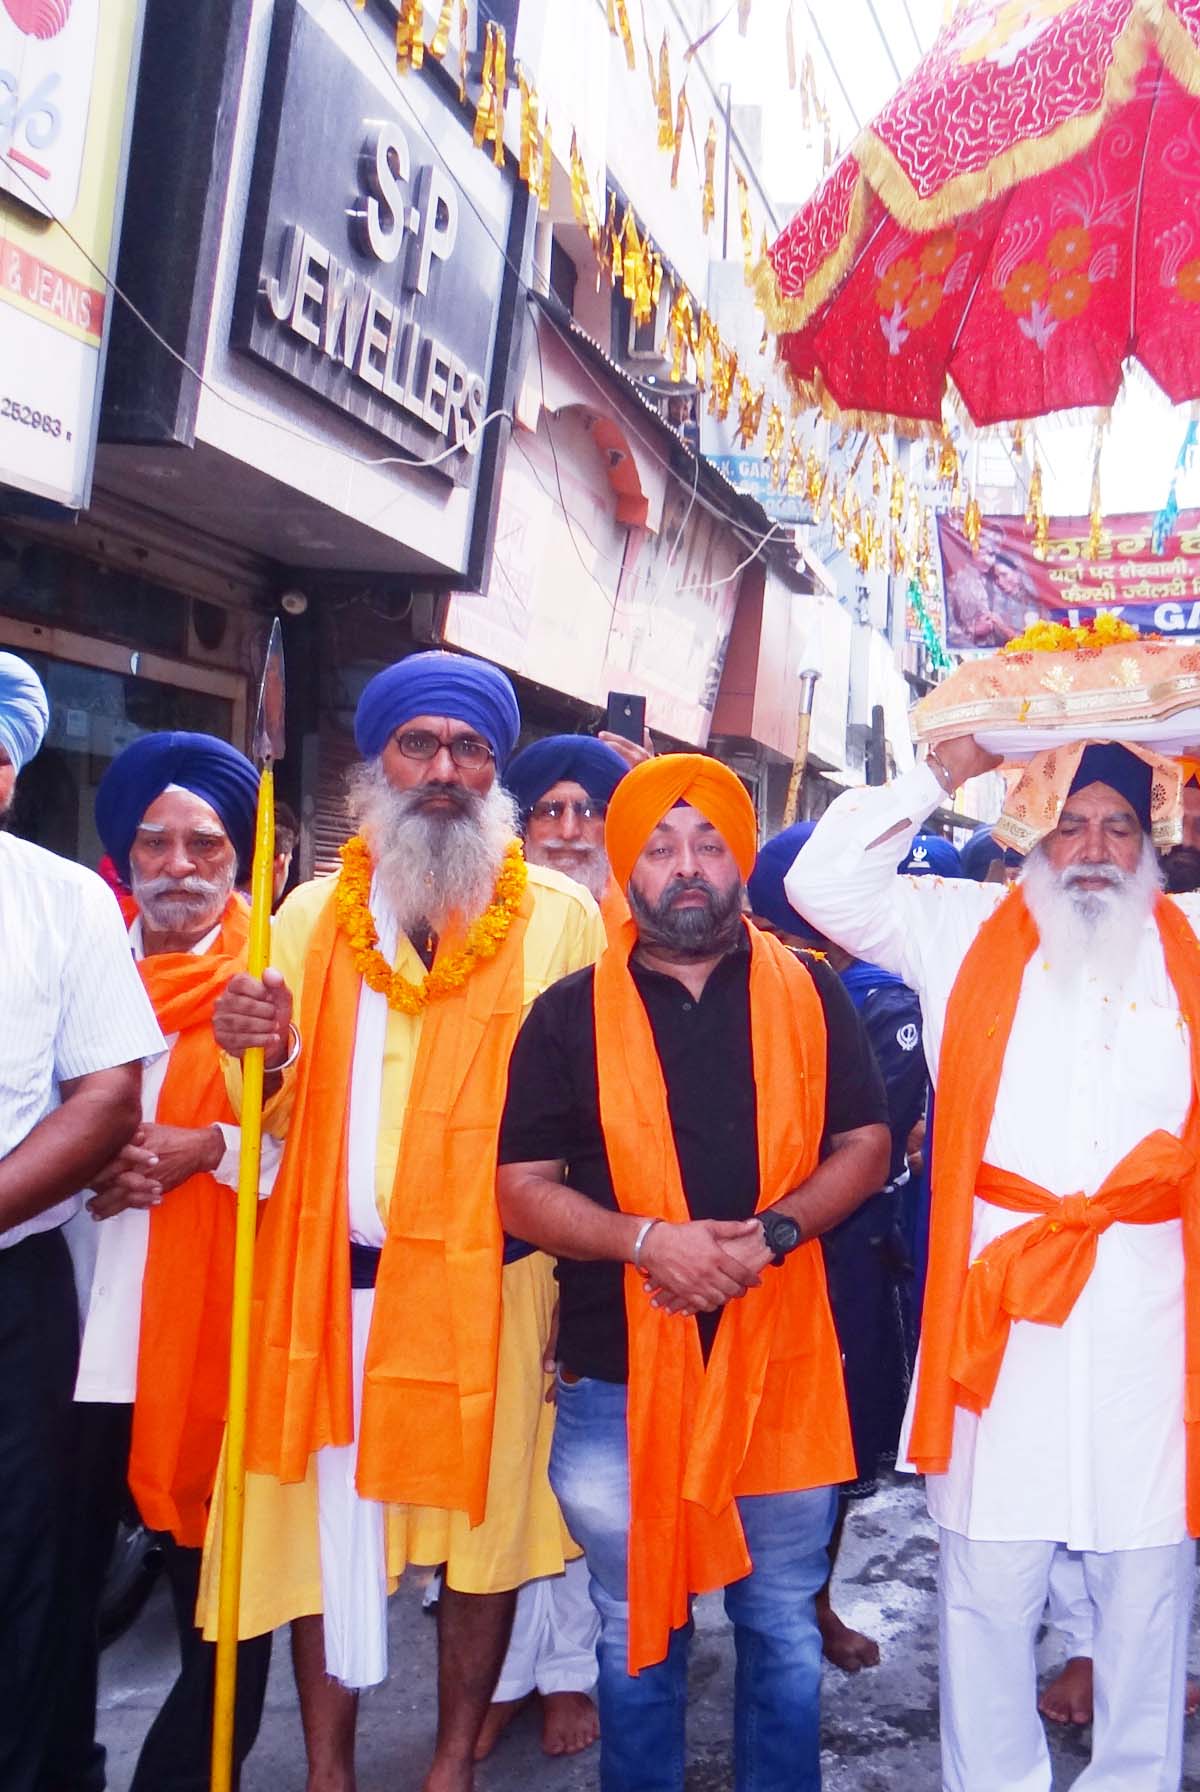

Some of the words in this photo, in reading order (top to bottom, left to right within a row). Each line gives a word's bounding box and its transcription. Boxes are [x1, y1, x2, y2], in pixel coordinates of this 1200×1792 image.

[6, 262, 22, 291] &
[28, 271, 92, 331] JEANS
[262, 225, 486, 454] JEWELLERS
[1089, 565, 1115, 580] पर
